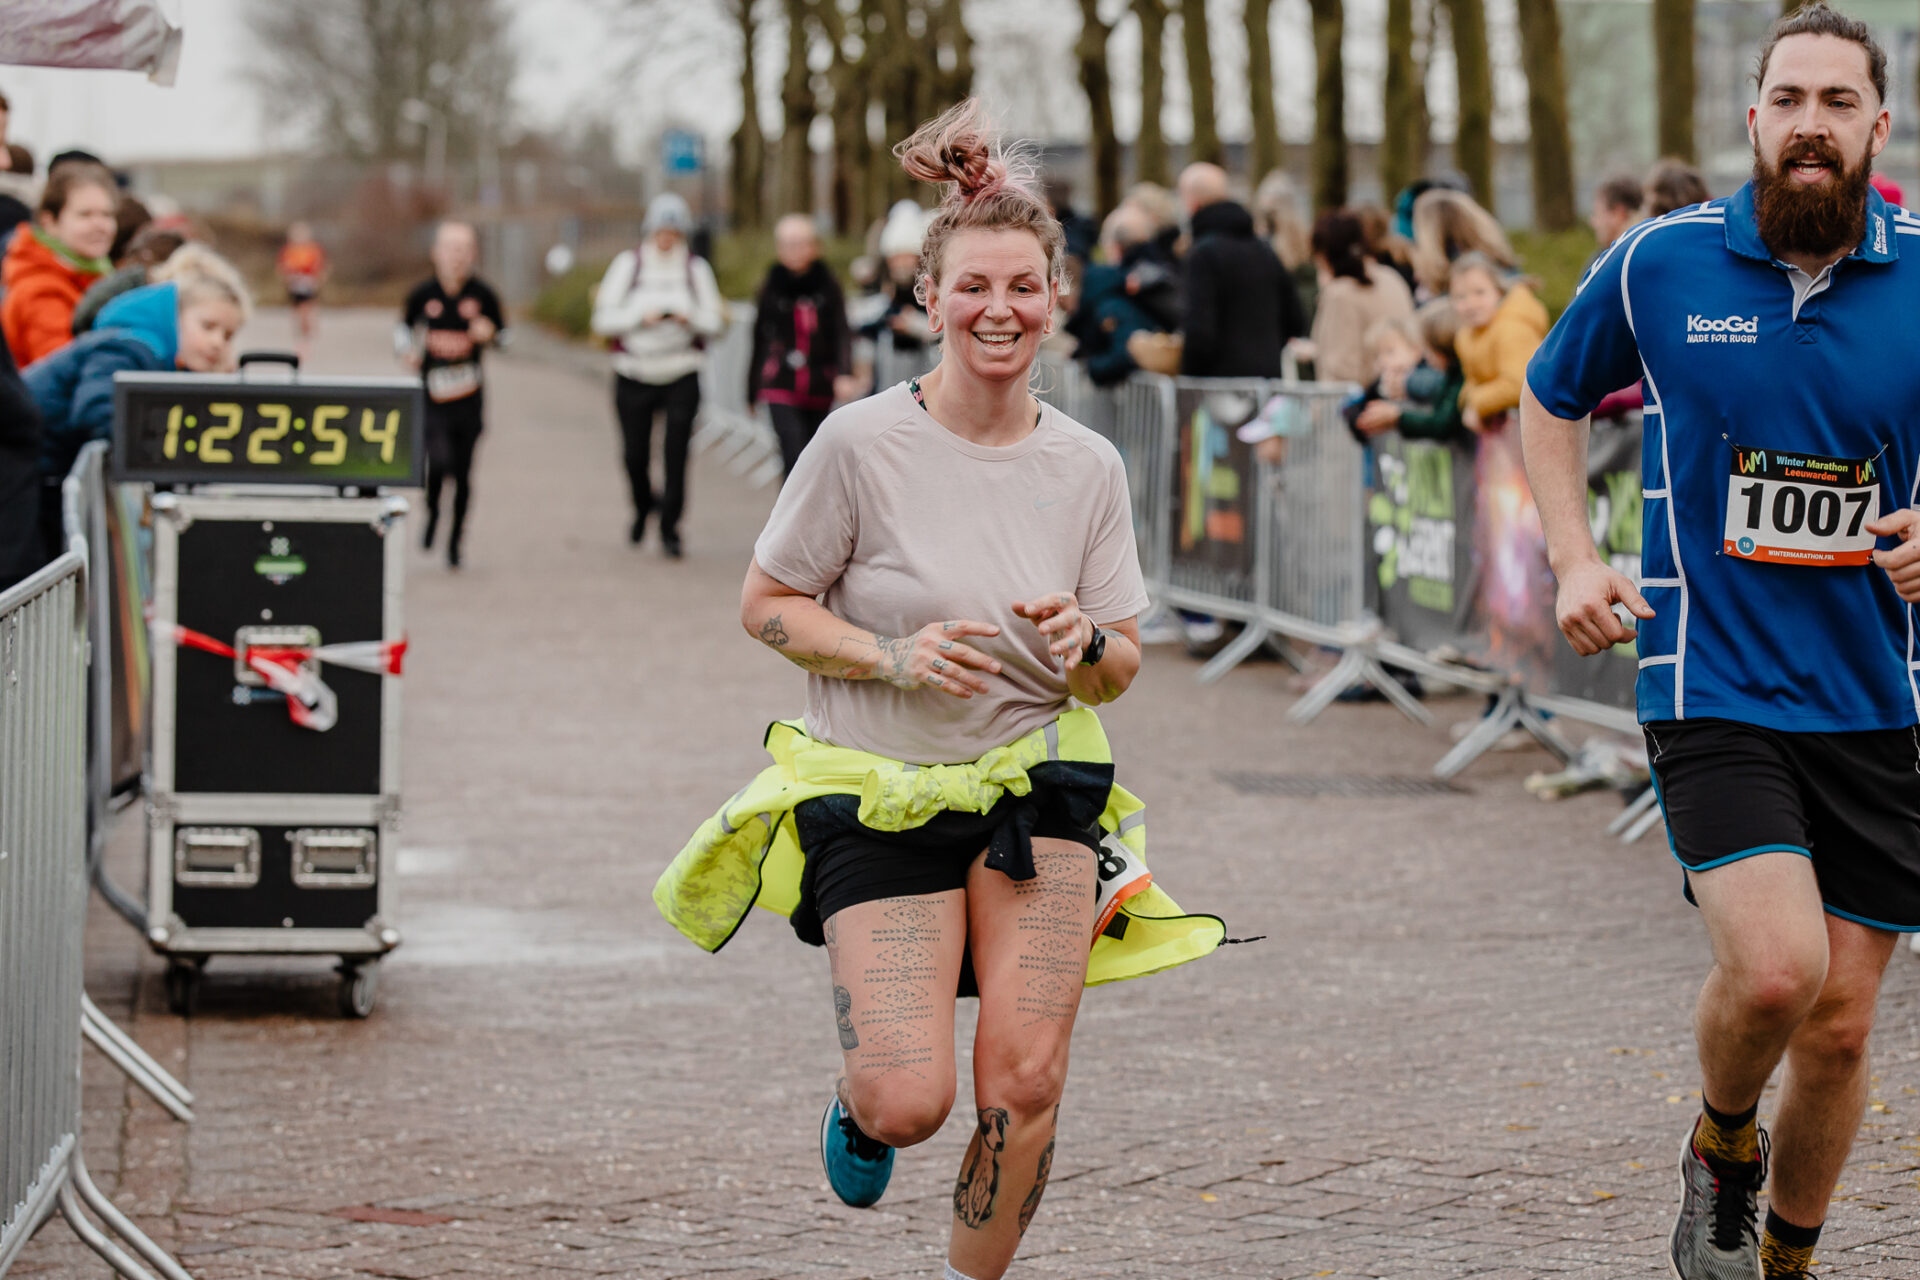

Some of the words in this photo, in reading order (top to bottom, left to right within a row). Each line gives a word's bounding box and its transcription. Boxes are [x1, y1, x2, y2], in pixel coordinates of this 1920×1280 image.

[1687, 314, 1758, 333] KooGa
[1686, 334, 1710, 343] MADE
[1711, 334, 1728, 343] FOR
[1729, 334, 1758, 344] RUGBY
[163, 402, 400, 465] 1:22:54
[1776, 455, 1806, 467] Winter
[1806, 459, 1849, 473] Marathon
[1785, 467, 1838, 482] Leeuwarden
[1741, 482, 1872, 537] 1007
[1768, 549, 1835, 561] WINTERMARATHON.FRL
